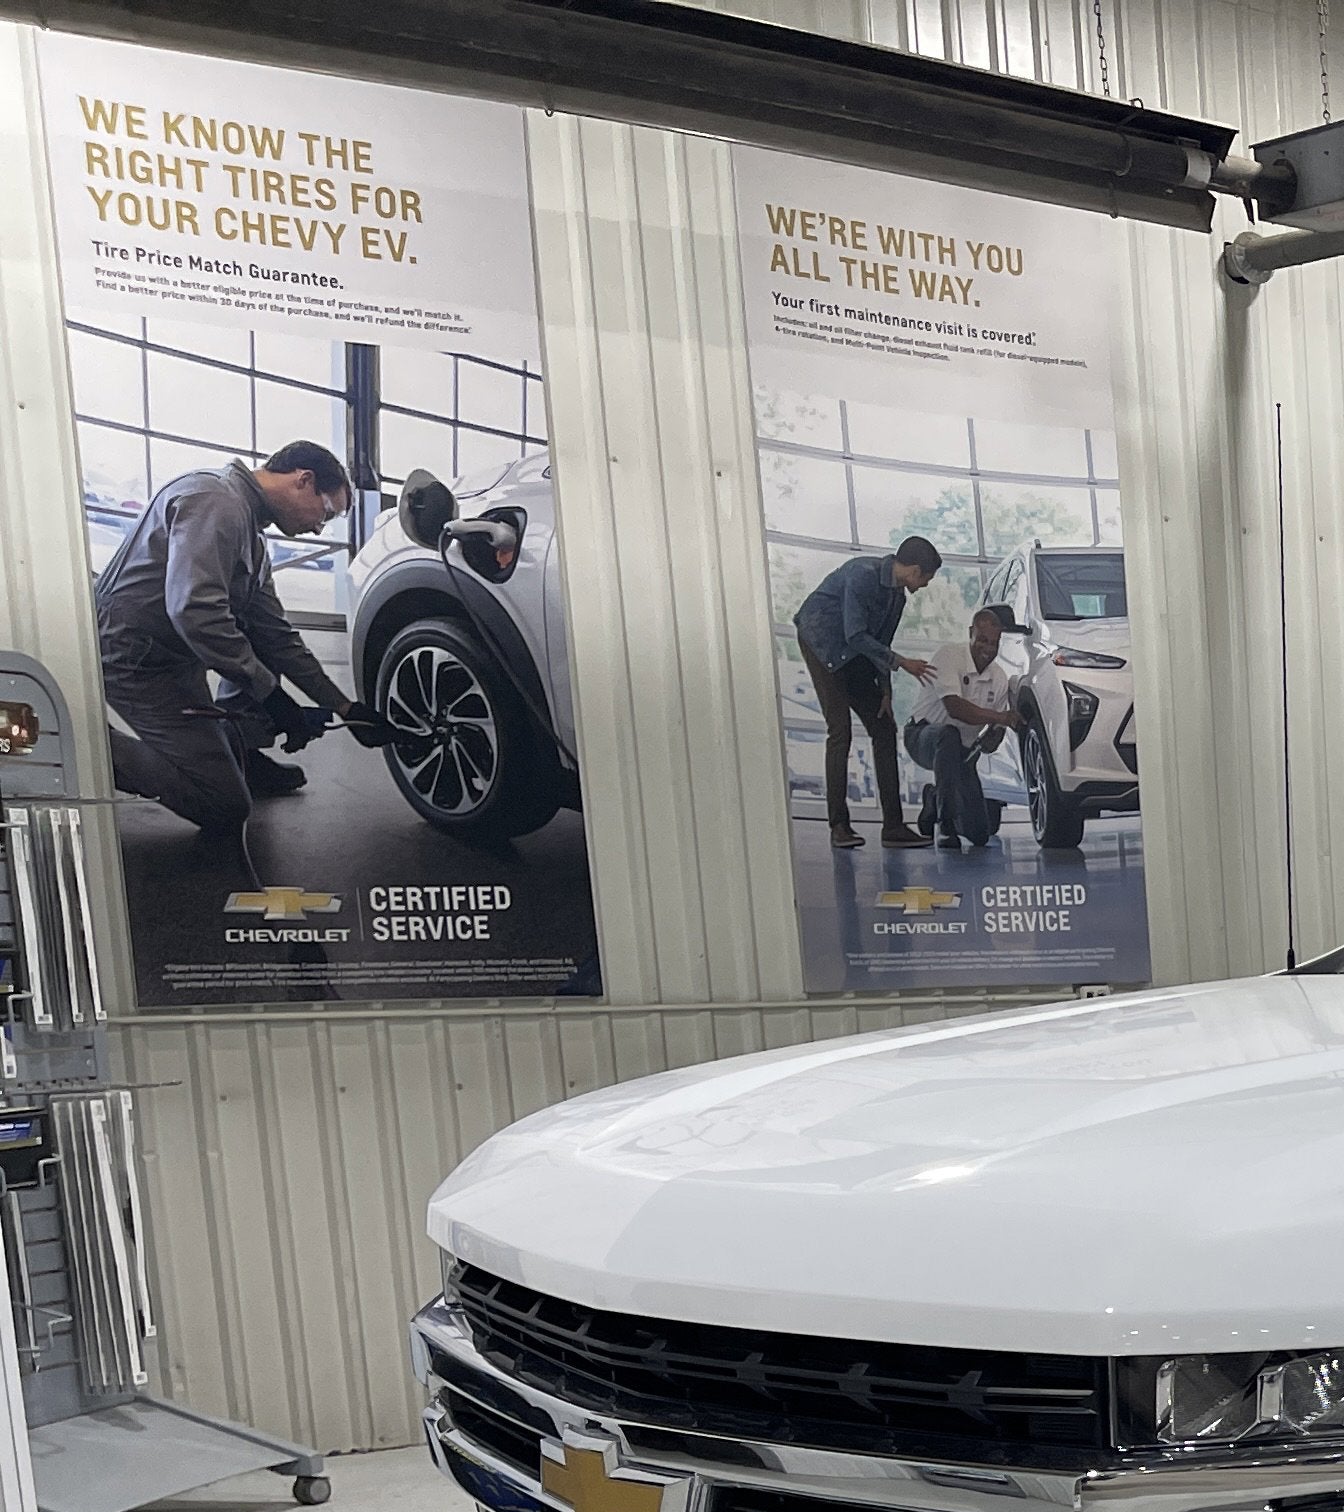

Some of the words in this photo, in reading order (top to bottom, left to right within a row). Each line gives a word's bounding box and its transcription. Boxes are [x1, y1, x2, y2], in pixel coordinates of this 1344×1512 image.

[78, 96, 147, 140] WE
[163, 111, 286, 162] KNOW
[298, 133, 374, 174] THE
[84, 142, 210, 191] RIGHT
[223, 165, 337, 213] TIRES
[350, 184, 424, 225] FOR
[85, 186, 200, 237] YOUR
[213, 207, 347, 258] CHEVY
[361, 227, 418, 265] EV.
[765, 204, 868, 252] WE'RE
[877, 224, 957, 267] WITH
[966, 240, 1024, 277] YOU
[91, 240, 131, 263] Tire
[135, 245, 184, 270] Price
[188, 253, 244, 279] Match
[248, 262, 345, 292] Guarantee.
[770, 244, 830, 284] ALL
[839, 256, 900, 295] THE
[908, 268, 982, 308] WAY.
[94, 266, 132, 280] Provide
[134, 275, 146, 283] us
[148, 273, 170, 286] with
[180, 279, 211, 291] better
[213, 284, 247, 297] eligible
[249, 289, 272, 300] price
[286, 293, 302, 303] the
[304, 296, 324, 306] time
[326, 298, 336, 307] of
[338, 300, 383, 313] purchase,
[384, 306, 400, 315] and
[424, 310, 451, 320] match
[95, 279, 117, 291] Find
[128, 284, 159, 296] better
[161, 290, 186, 300] price
[234, 300, 256, 311] days
[258, 302, 268, 311] of
[269, 304, 285, 313] the
[287, 307, 333, 320] purchase,
[334, 312, 351, 321] and
[375, 316, 405, 327] refund
[407, 320, 421, 329] the
[771, 291, 805, 310] Your
[808, 298, 840, 317] first
[844, 308, 932, 332] maintenance
[934, 320, 963, 336] visit
[967, 324, 978, 338] is
[369, 885, 511, 913] CERTIFIED
[981, 884, 1086, 908] CERTIFIED
[225, 928, 351, 944] CHEVROLET
[372, 914, 491, 942] SERVICE
[873, 922, 968, 934] CHEVROLET
[983, 910, 1072, 933] SERVICE
